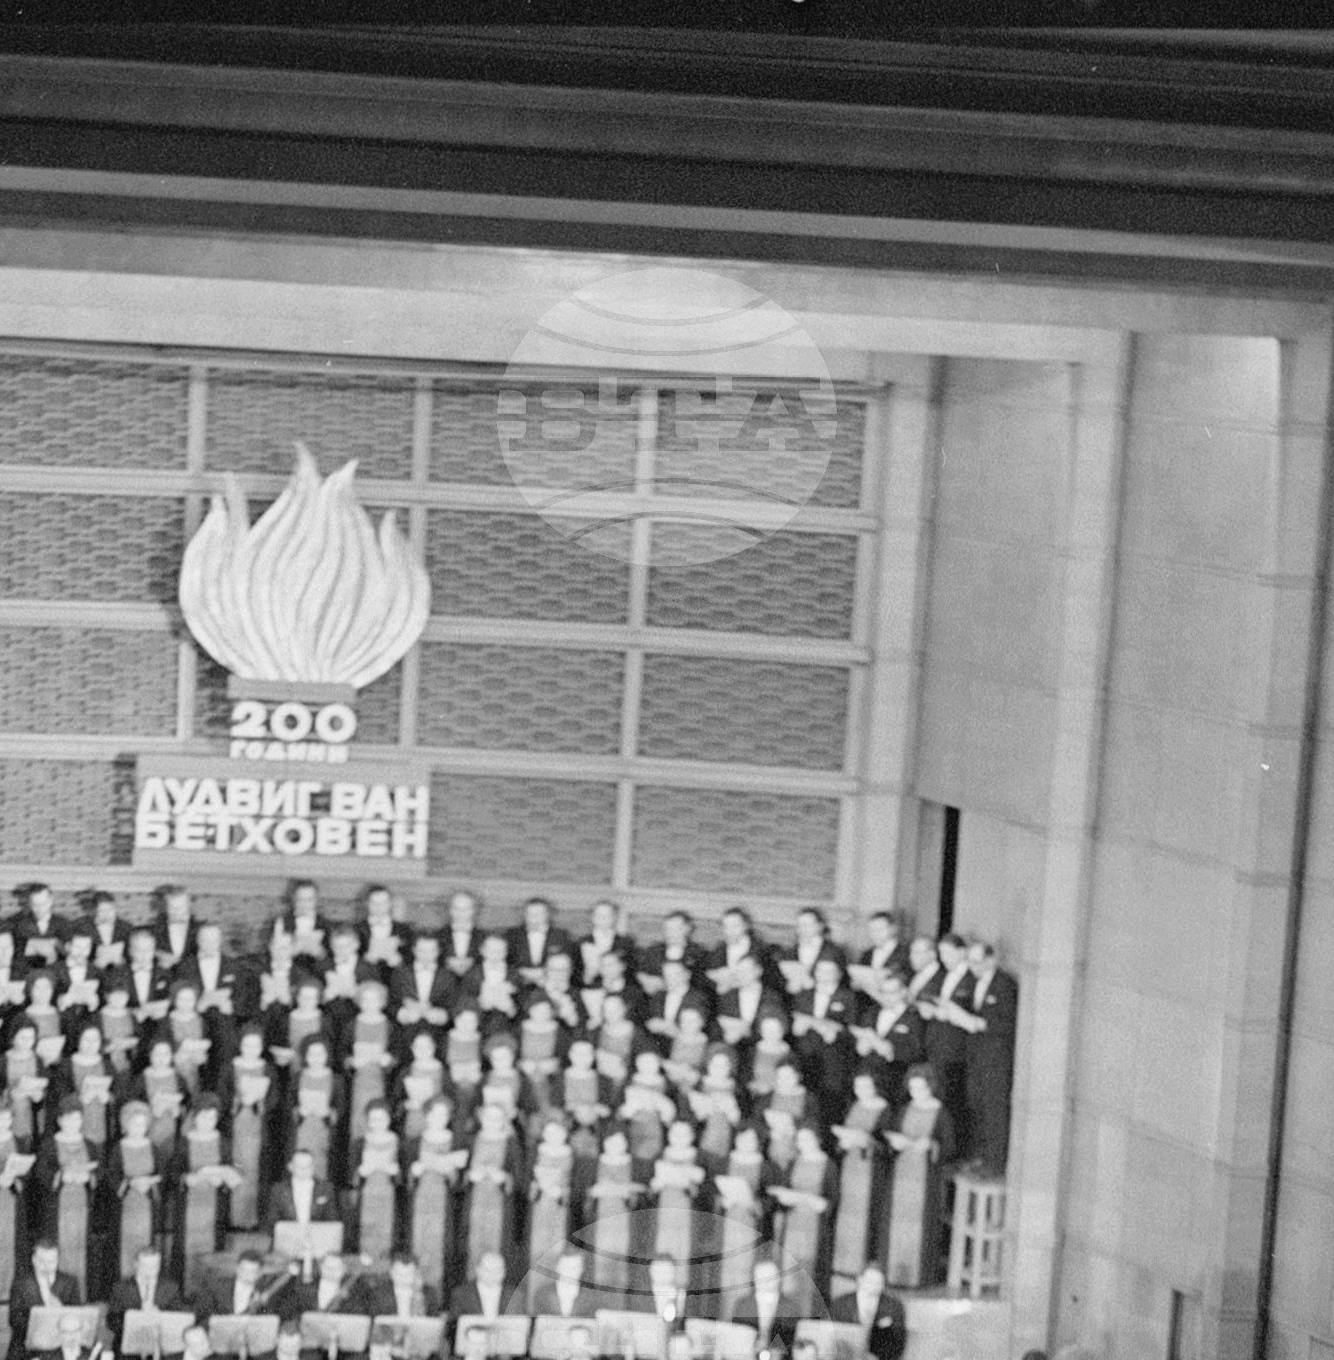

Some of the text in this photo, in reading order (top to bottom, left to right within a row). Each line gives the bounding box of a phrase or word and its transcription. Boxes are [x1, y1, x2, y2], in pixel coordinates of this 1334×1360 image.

[229, 699, 358, 743] 200
[138, 776, 430, 823] ЛУДВИГ ВАН
[135, 812, 429, 858] БЕТХОВЕН
